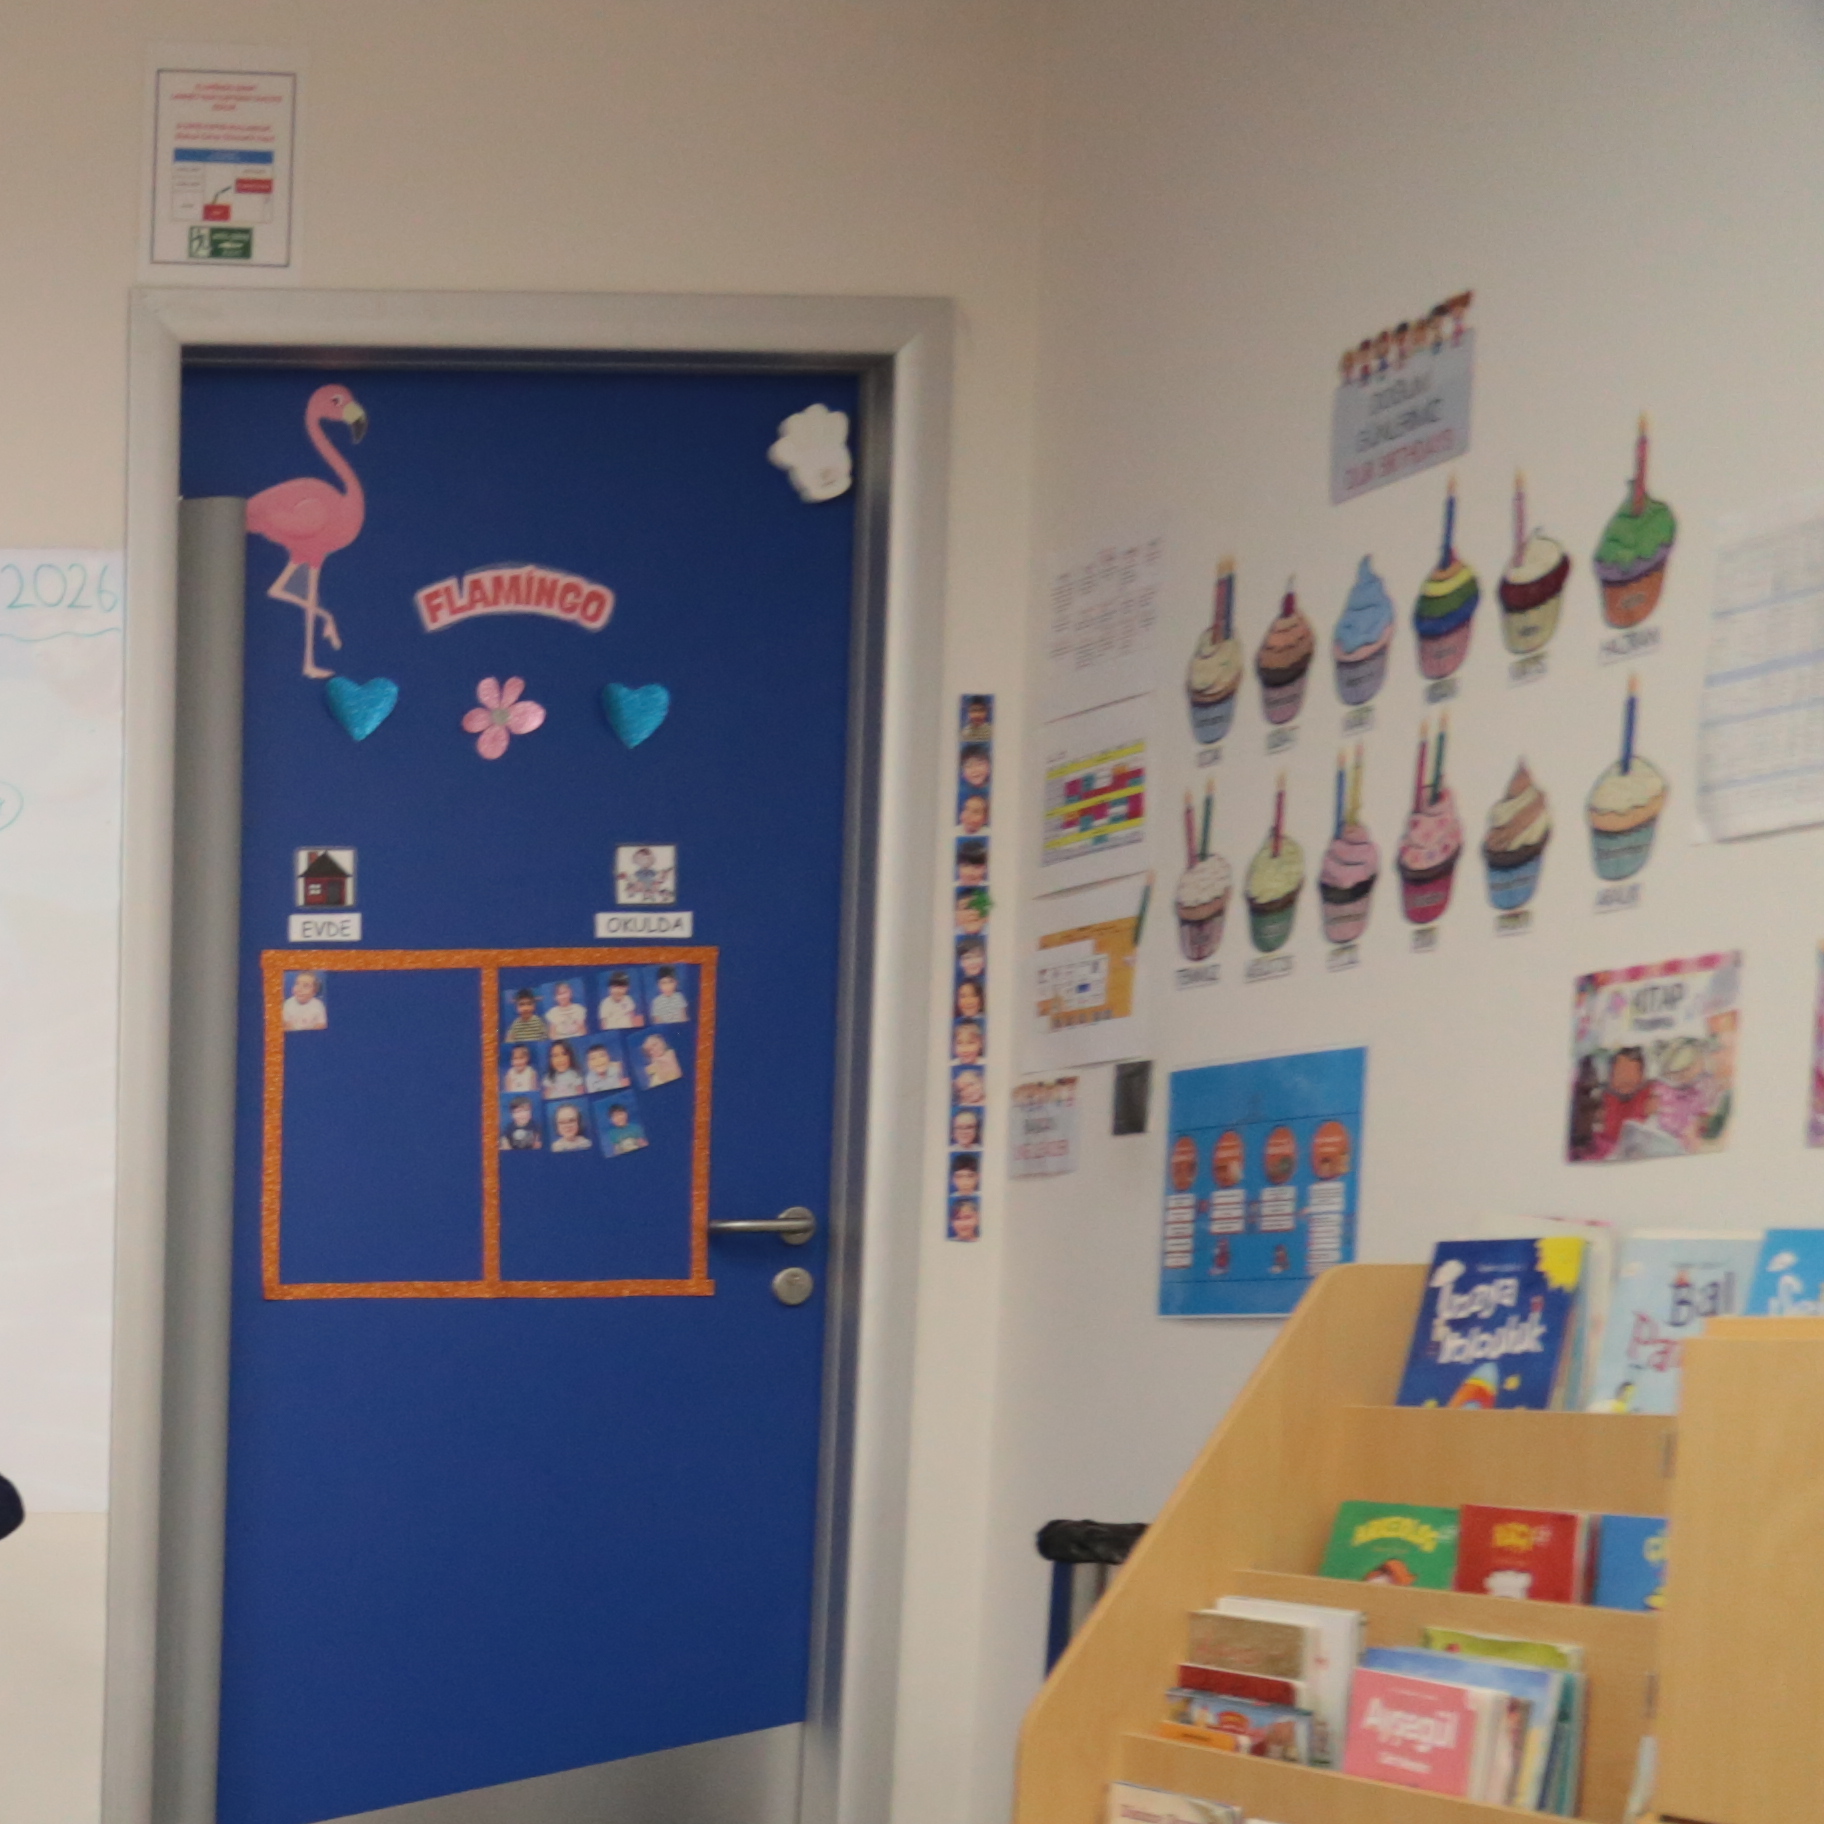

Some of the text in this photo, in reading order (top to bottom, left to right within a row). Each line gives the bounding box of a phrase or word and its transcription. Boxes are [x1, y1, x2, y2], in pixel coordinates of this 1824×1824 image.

[0, 563, 120, 613] 2026
[422, 568, 609, 626] FLAMİNGO
[302, 920, 352, 939] EVDE
[606, 916, 685, 936] OKULDA
